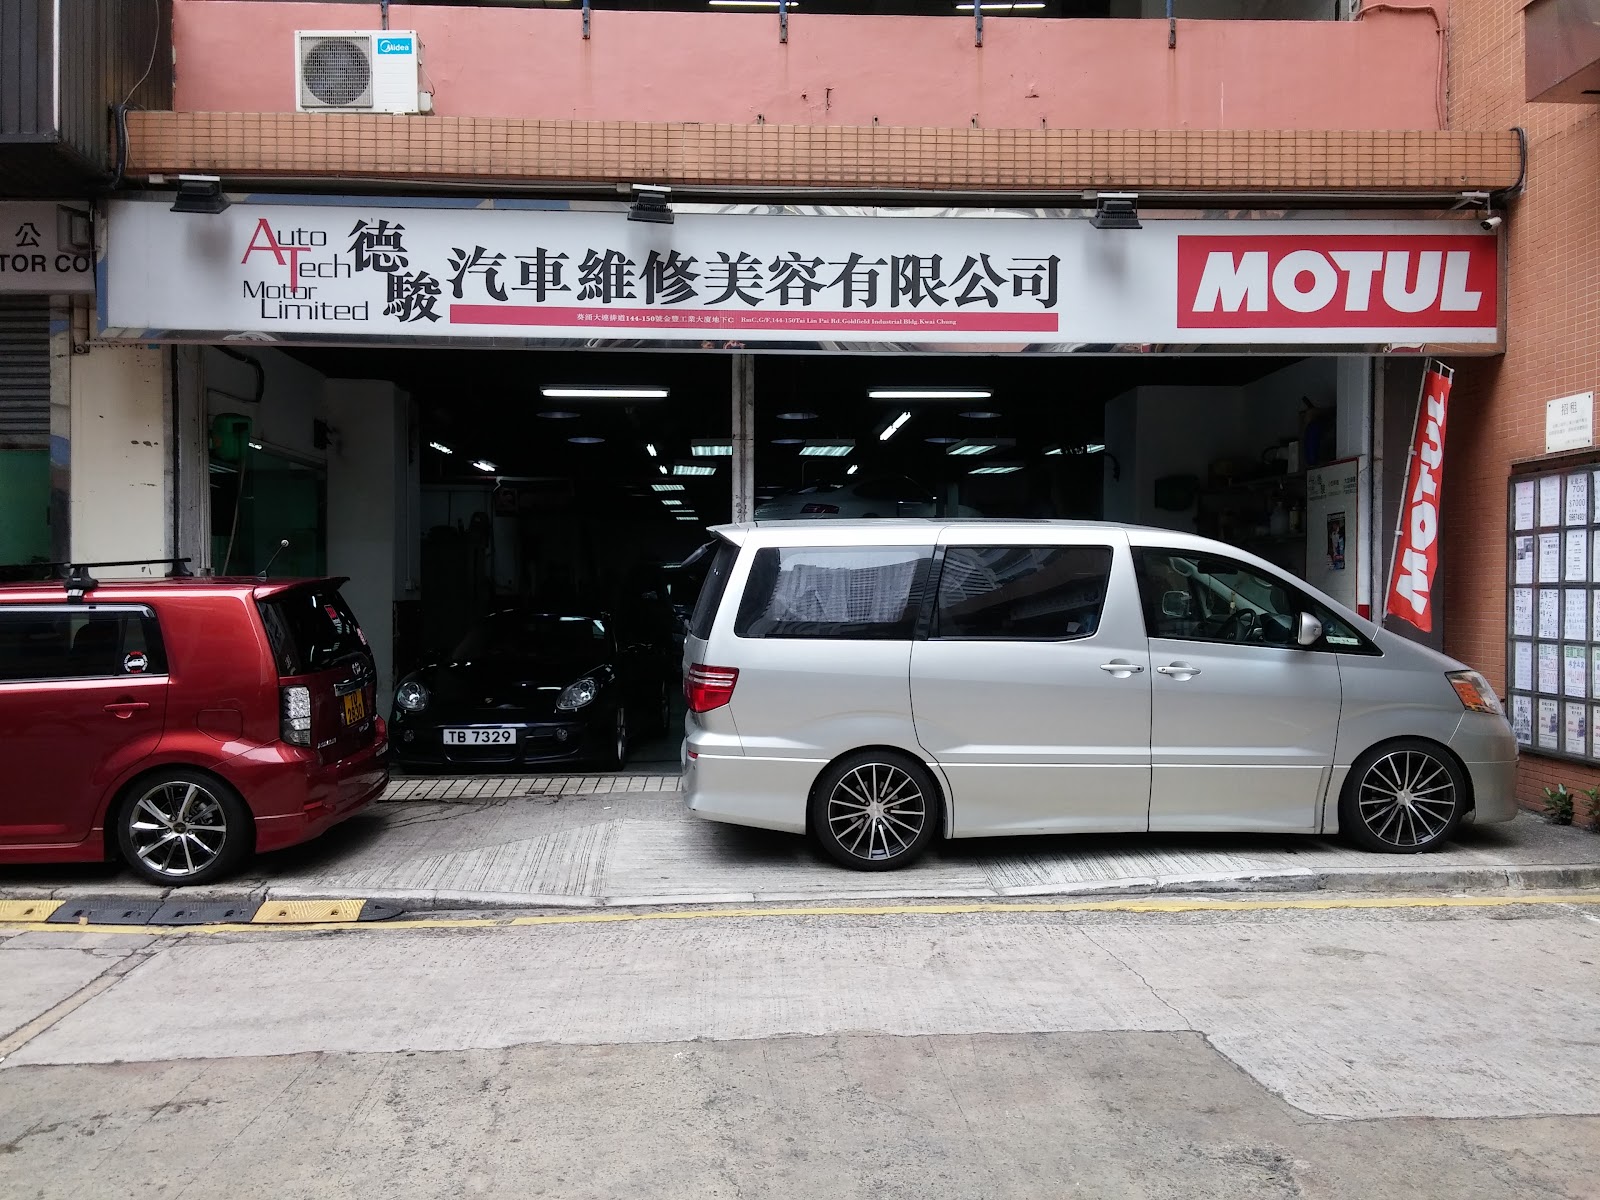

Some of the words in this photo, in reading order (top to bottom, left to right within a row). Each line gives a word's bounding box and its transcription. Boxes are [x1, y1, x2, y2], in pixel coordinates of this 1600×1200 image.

[381, 41, 409, 52] Midea
[15, 222, 41, 247] 公
[241, 218, 327, 265] Auto
[277, 247, 351, 293] Tech
[446, 245, 1061, 308] 汽車維修美容有限公司
[1192, 250, 1482, 313] MOTUL
[243, 280, 318, 300] Motor
[261, 299, 369, 321] Limited
[936, 318, 957, 326] Chung
[1396, 392, 1445, 615] MOTUL
[448, 730, 466, 743] TB
[471, 730, 511, 743] 7329
